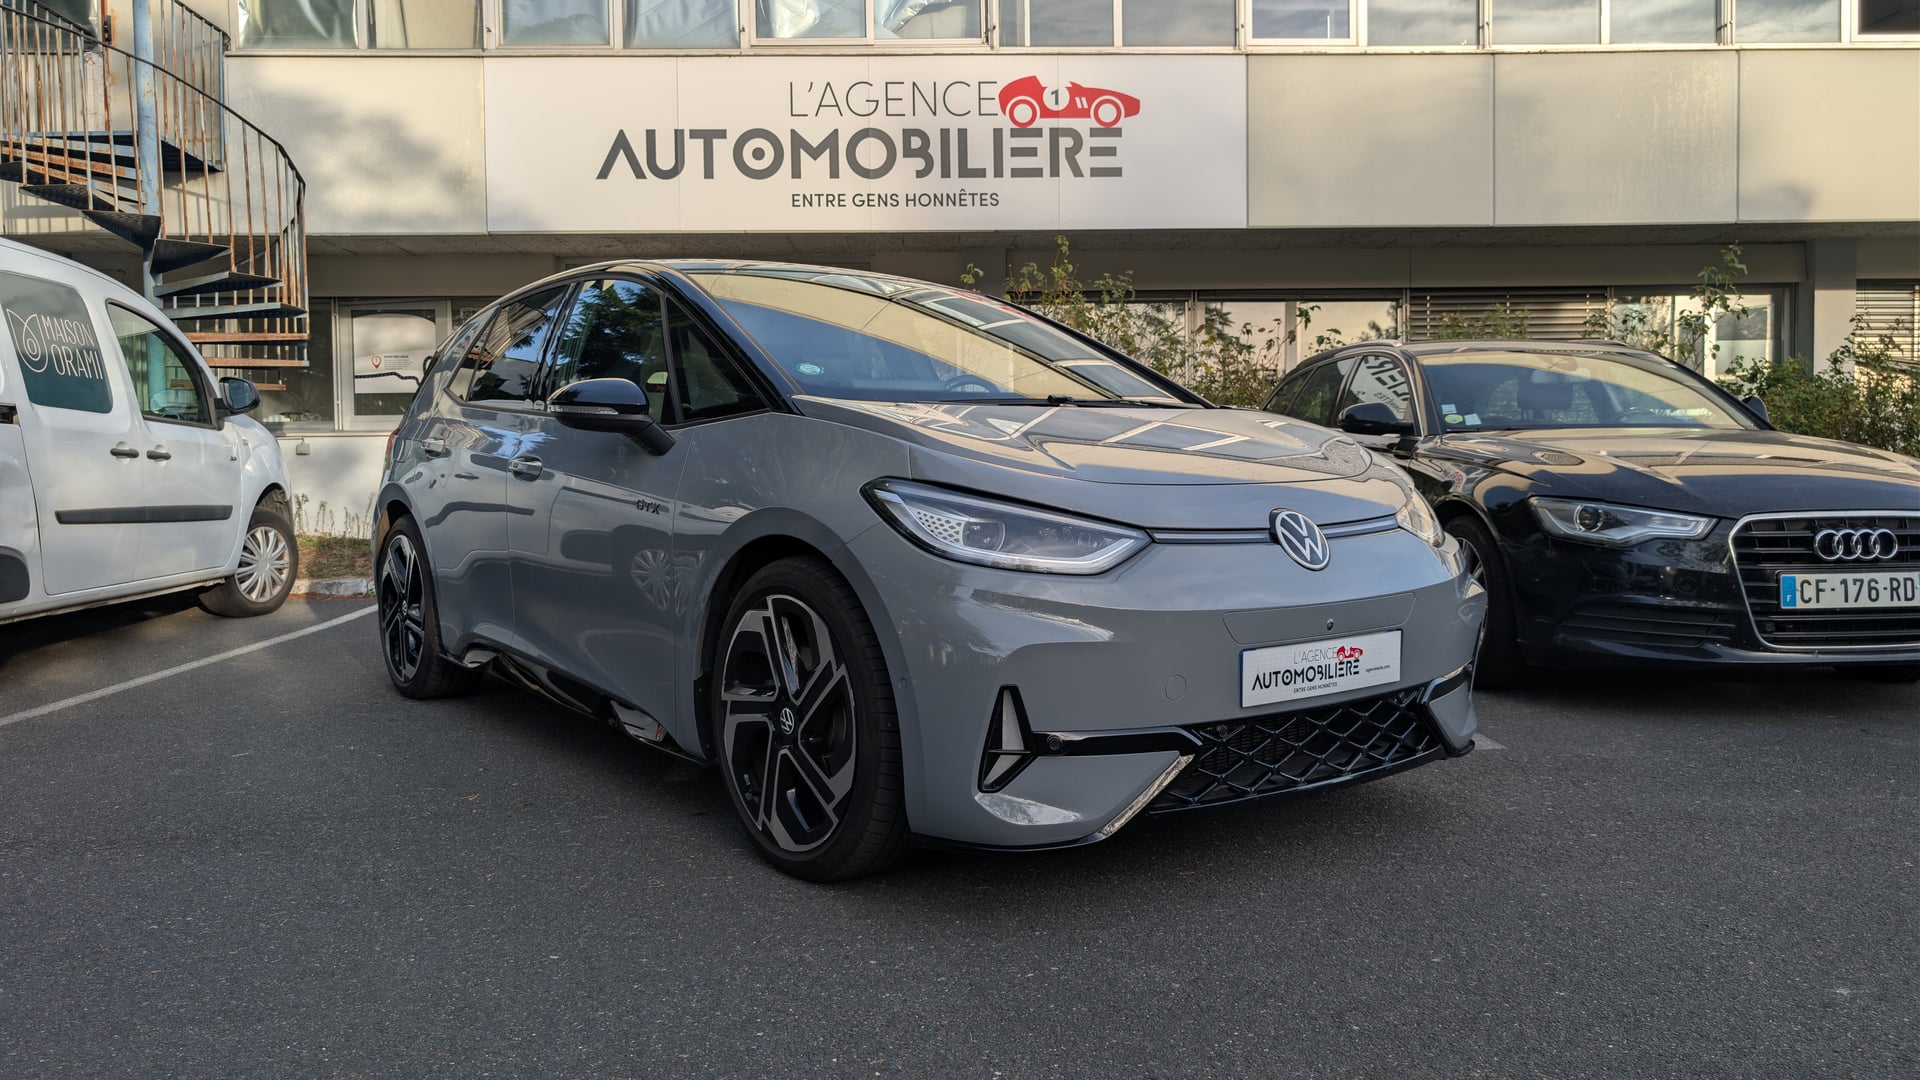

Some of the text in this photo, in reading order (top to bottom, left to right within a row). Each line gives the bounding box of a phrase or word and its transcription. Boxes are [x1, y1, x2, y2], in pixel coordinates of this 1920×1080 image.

[789, 80, 999, 117] L'AGENCE
[596, 127, 1123, 180] AUTOMOBILIERE
[791, 188, 1000, 208] ENTRE GENS HONNÊTES
[41, 314, 95, 348] MAISON
[51, 344, 104, 380] ORAMI
[635, 499, 661, 515] GTX
[1800, 577, 1916, 604] CF-176-RD
[1293, 647, 1338, 664] L'AGENCE
[1252, 659, 1360, 691] AUTOMOBILIERE
